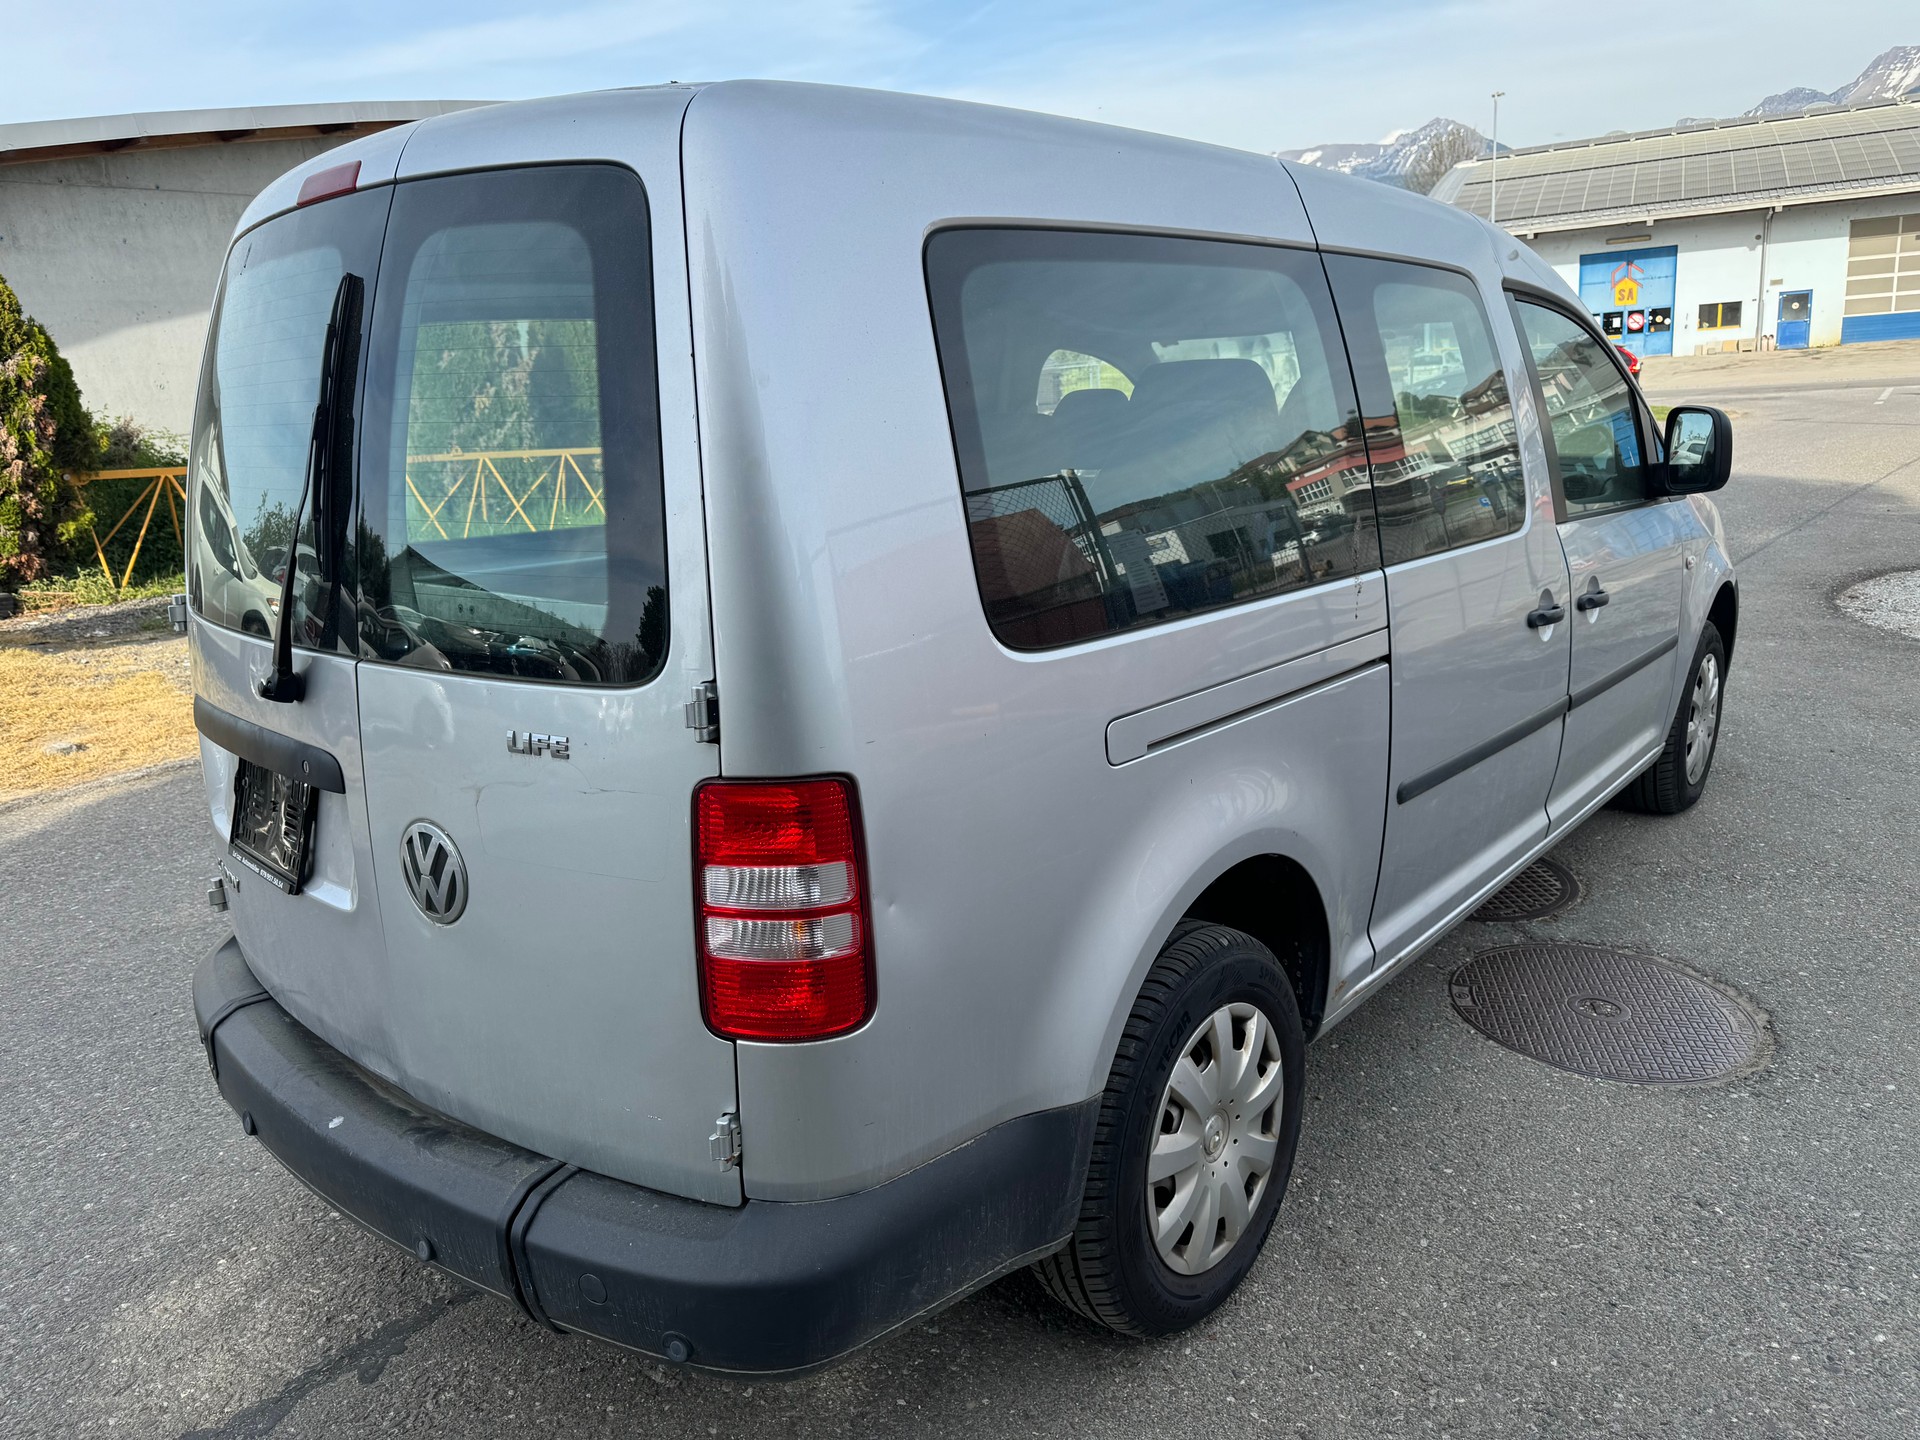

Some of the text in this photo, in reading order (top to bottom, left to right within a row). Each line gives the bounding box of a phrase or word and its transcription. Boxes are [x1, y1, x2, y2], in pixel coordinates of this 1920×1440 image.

[1618, 288, 1634, 301] SA
[506, 730, 570, 760] LIFE
[1156, 1011, 1191, 1072] TECAR
